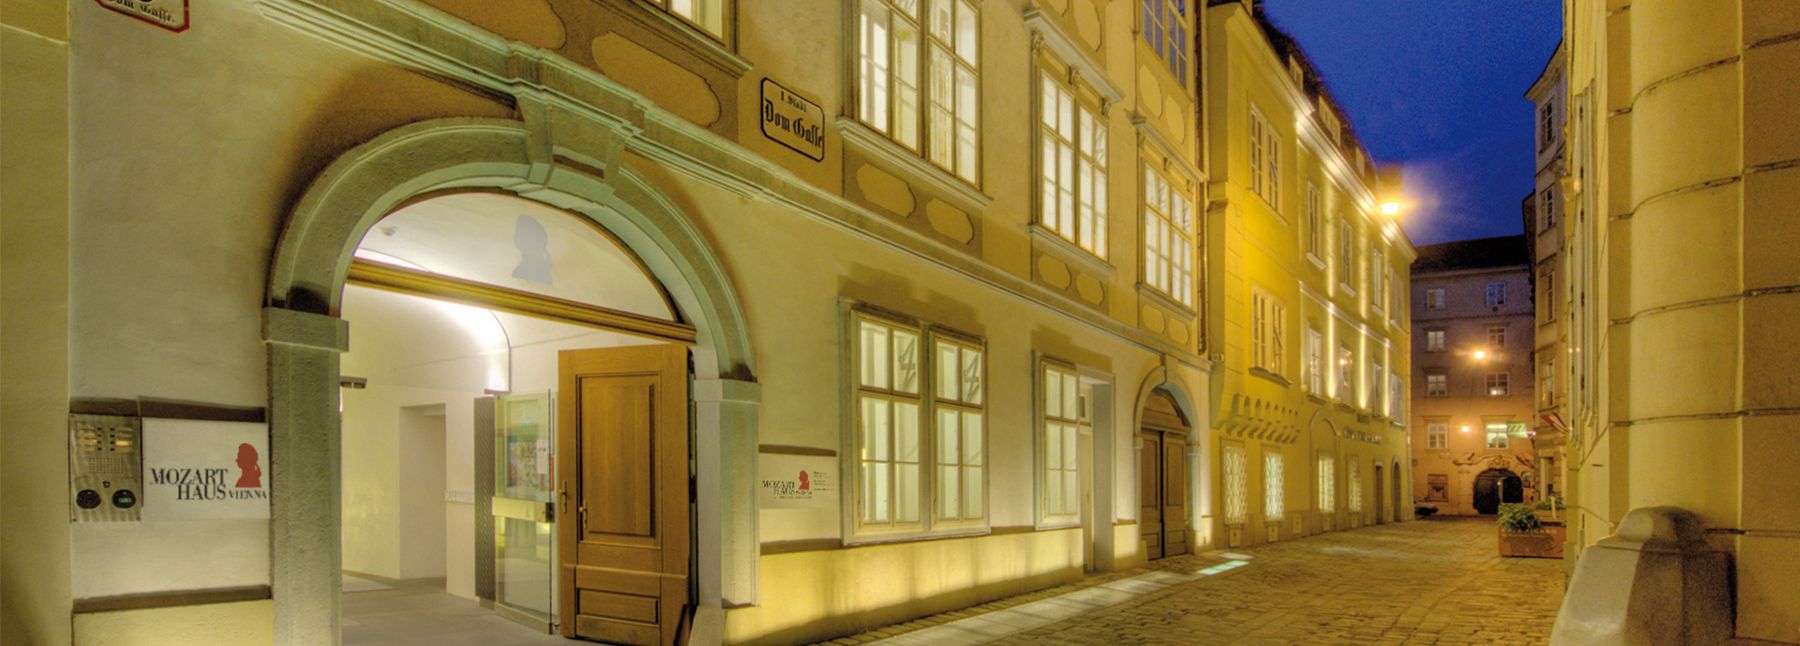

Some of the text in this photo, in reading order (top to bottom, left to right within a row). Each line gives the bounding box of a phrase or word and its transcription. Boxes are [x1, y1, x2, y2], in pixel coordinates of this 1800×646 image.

[765, 97, 790, 132] Dom
[149, 467, 228, 486] MOZART
[761, 480, 795, 489] MOZART
[176, 484, 267, 501] HAUS VIENNA
